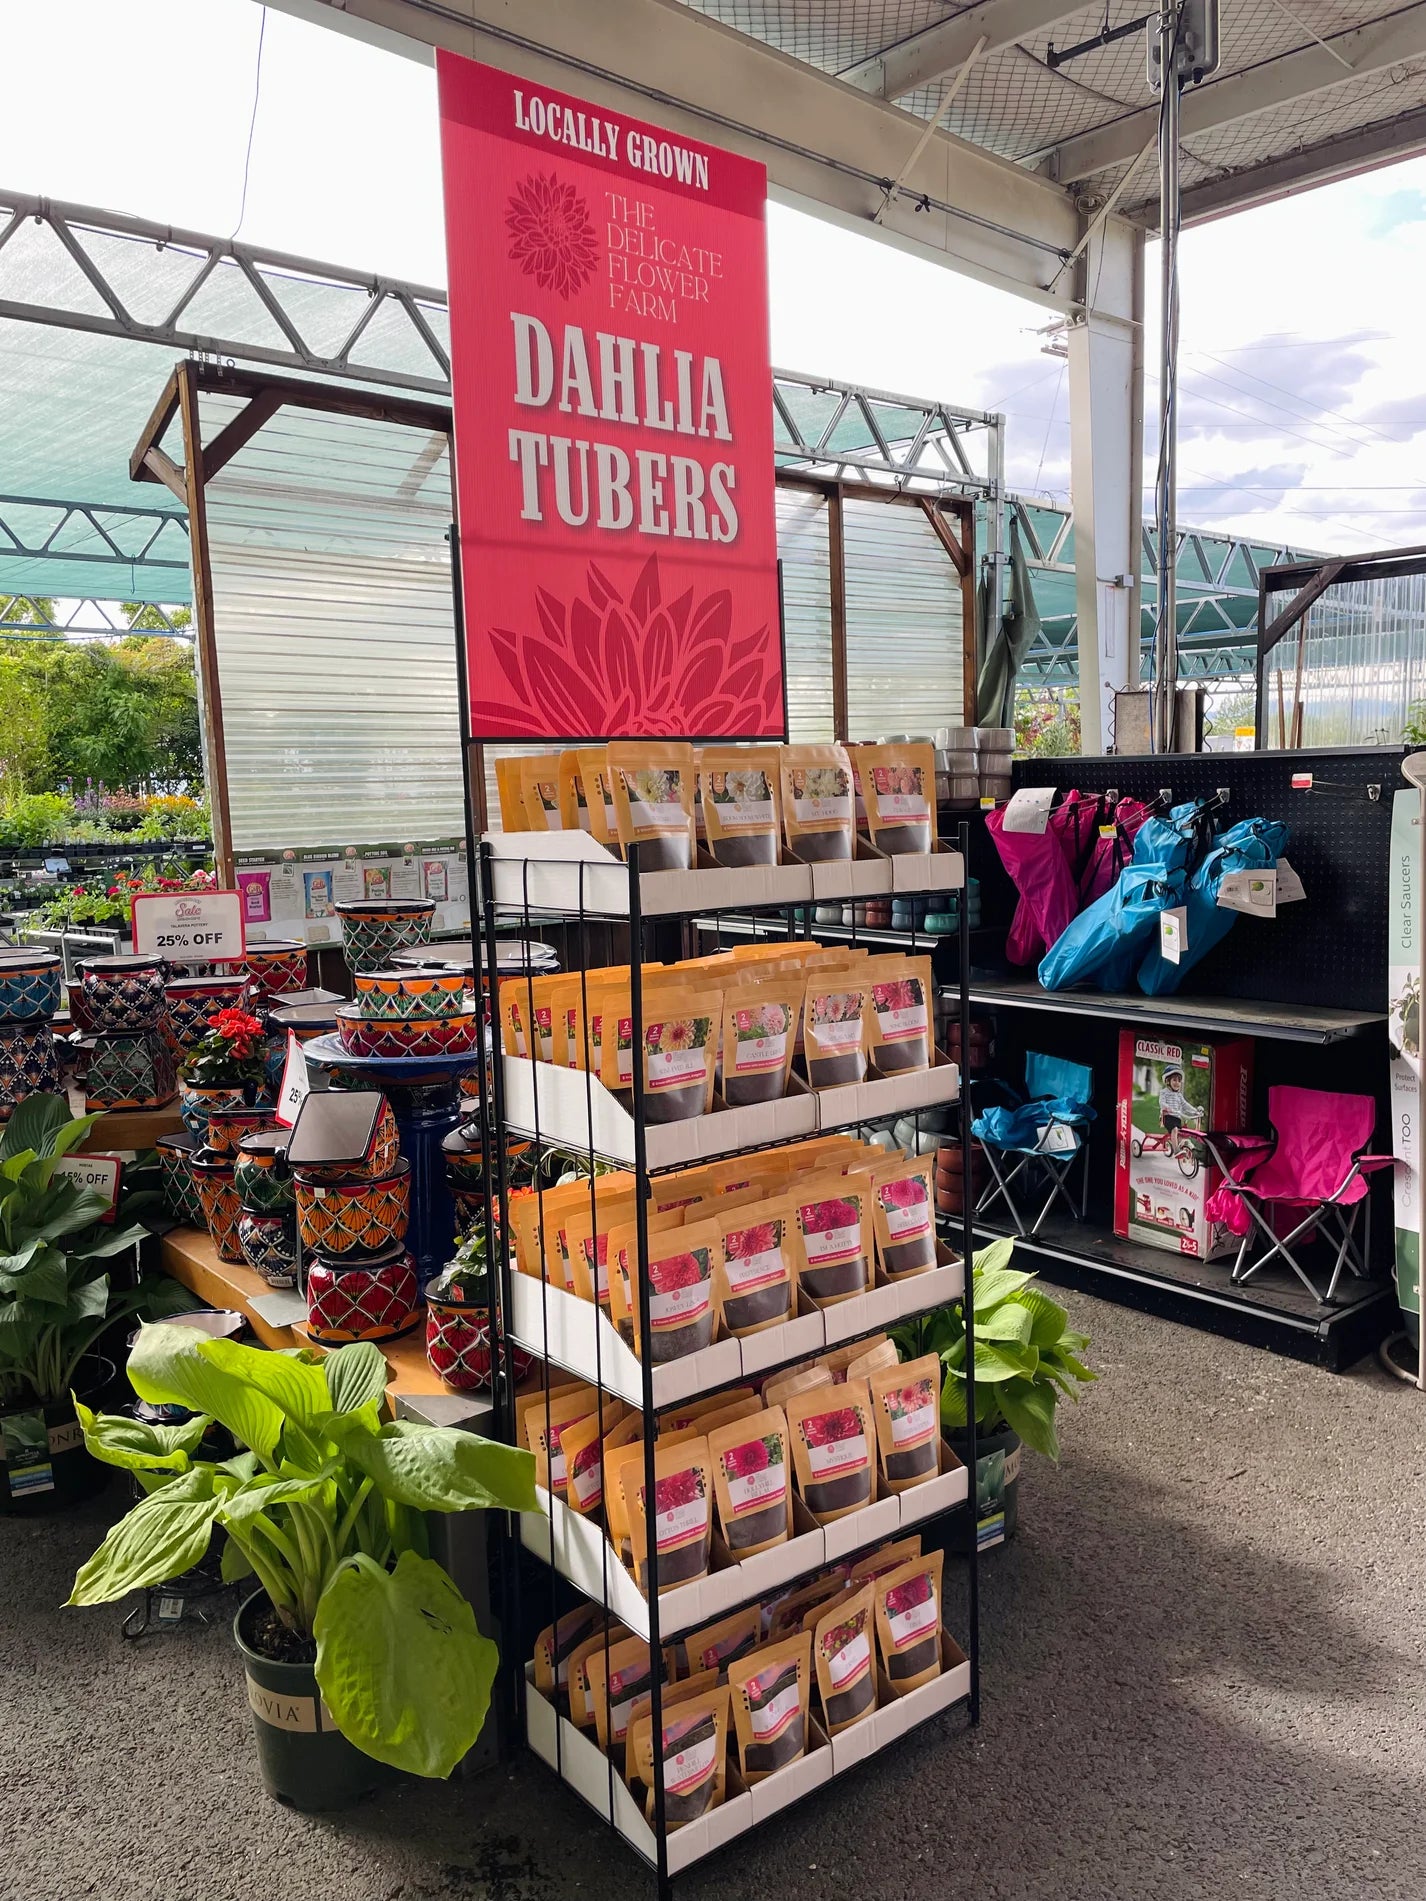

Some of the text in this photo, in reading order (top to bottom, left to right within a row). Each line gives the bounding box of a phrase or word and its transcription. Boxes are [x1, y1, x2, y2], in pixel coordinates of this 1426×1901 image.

[514, 90, 709, 190] LOCALLY GROWN
[605, 191, 656, 231] THE
[607, 222, 724, 278] DELICATE
[608, 254, 710, 304] FLOWER
[609, 283, 677, 324] FARM
[509, 311, 733, 442] DAHLIA
[508, 428, 739, 543] TUBERS
[175, 902, 202, 917] Sale
[1401, 855, 1412, 949] Clear Saucers
[157, 932, 223, 947] 25% OFF
[1167, 1047, 1180, 1058] RED
[1394, 1084, 1417, 1092] Surfaces
[1396, 1073, 1415, 1082] Protect
[87, 1173, 108, 1185] OFF
[251, 1688, 299, 1722] OVIA
